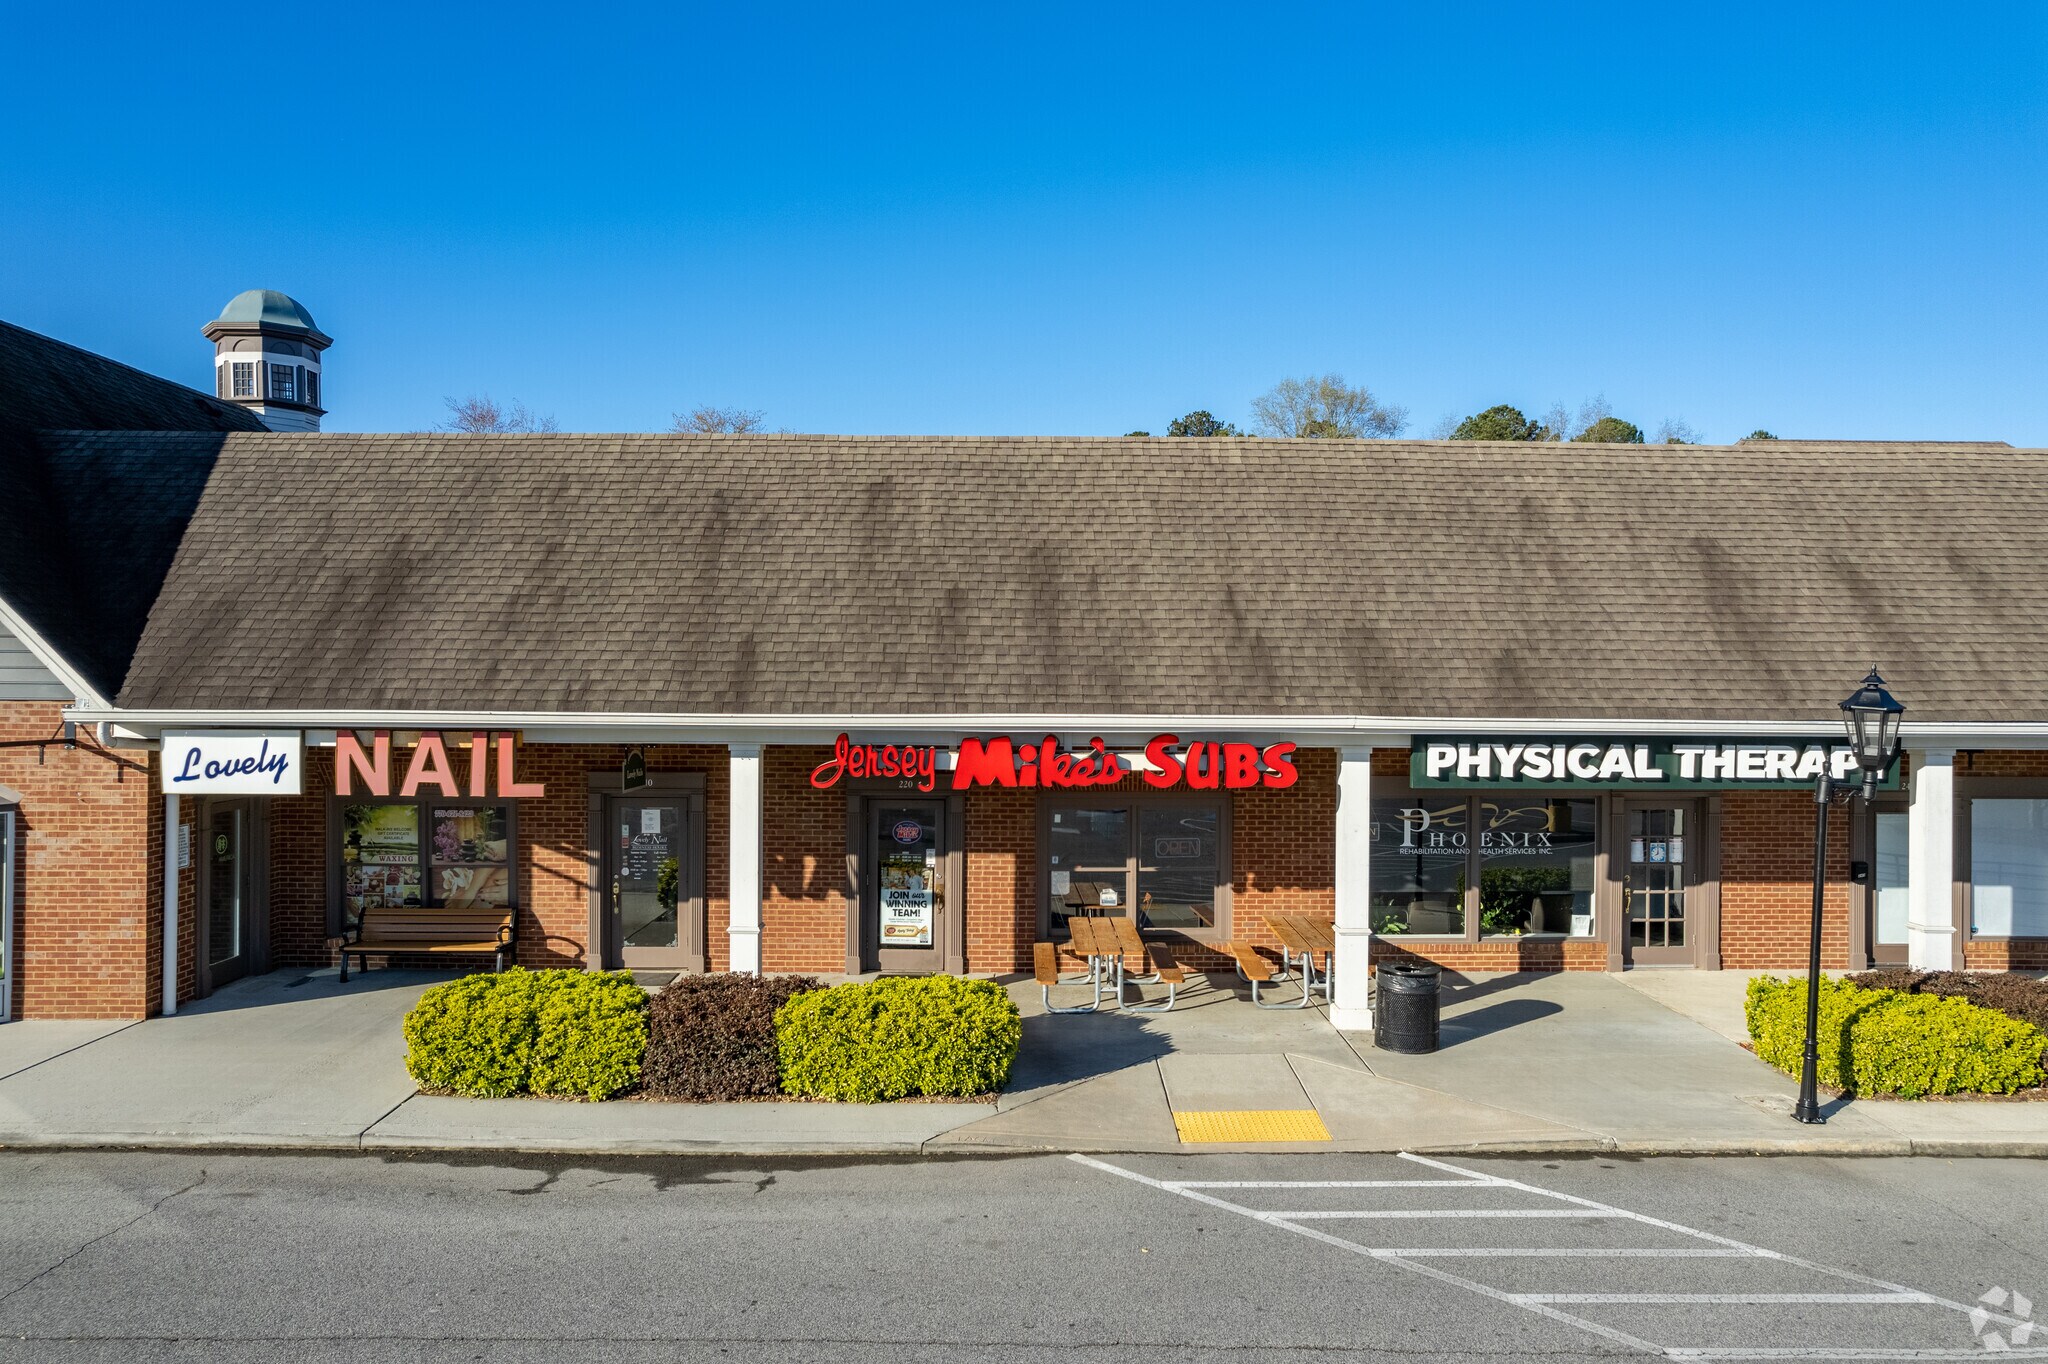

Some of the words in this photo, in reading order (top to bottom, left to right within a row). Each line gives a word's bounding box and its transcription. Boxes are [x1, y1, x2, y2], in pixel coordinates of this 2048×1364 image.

[173, 739, 289, 784] Lovely
[335, 730, 545, 798] NAIL
[810, 732, 936, 792] Jersey
[952, 734, 1130, 790] Mike's
[1143, 733, 1299, 789] SUBS
[1426, 743, 1663, 779] PHYSICAL
[1673, 744, 1884, 780] THERAP
[898, 780, 914, 789] 220
[1400, 808, 1553, 847] PHOENIX
[1157, 840, 1200, 856] OPEN
[886, 900, 928, 908] WINNING
[889, 891, 910, 899] JOIN
[892, 909, 921, 917] TEAM!
